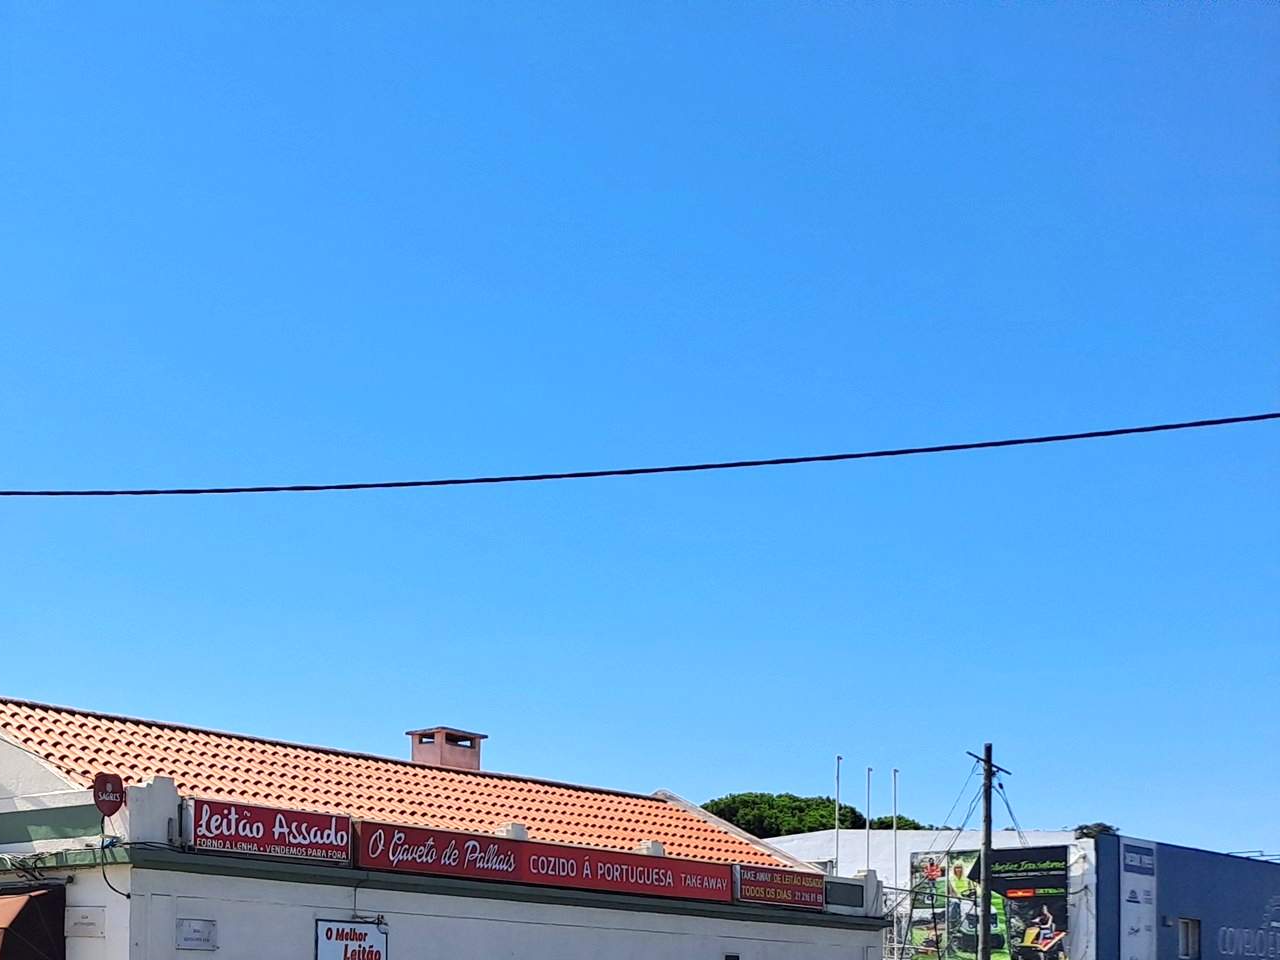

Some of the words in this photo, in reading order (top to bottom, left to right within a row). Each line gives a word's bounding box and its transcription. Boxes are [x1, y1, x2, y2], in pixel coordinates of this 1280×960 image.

[196, 803, 264, 838] Leitão
[272, 813, 348, 846] Assado
[196, 837, 224, 849] FORNO
[225, 841, 232, 849] A
[232, 842, 258, 852] LENHA
[265, 844, 307, 856] VENDEMOS
[307, 848, 327, 858] PARA
[327, 850, 347, 860] FORA
[368, 829, 385, 858] O
[389, 829, 437, 867] Gaveto
[440, 840, 460, 866] de
[464, 840, 516, 872] Palhais
[529, 855, 577, 877] COZIDO
[597, 862, 674, 887] PORTUGUESA
[680, 874, 701, 888] TAKE
[702, 876, 728, 891] AWAY
[741, 885, 765, 897] TODOS
[766, 887, 776, 899] OS
[777, 889, 792, 900] DIAS
[325, 927, 333, 940] O
[335, 927, 368, 942] Melhor
